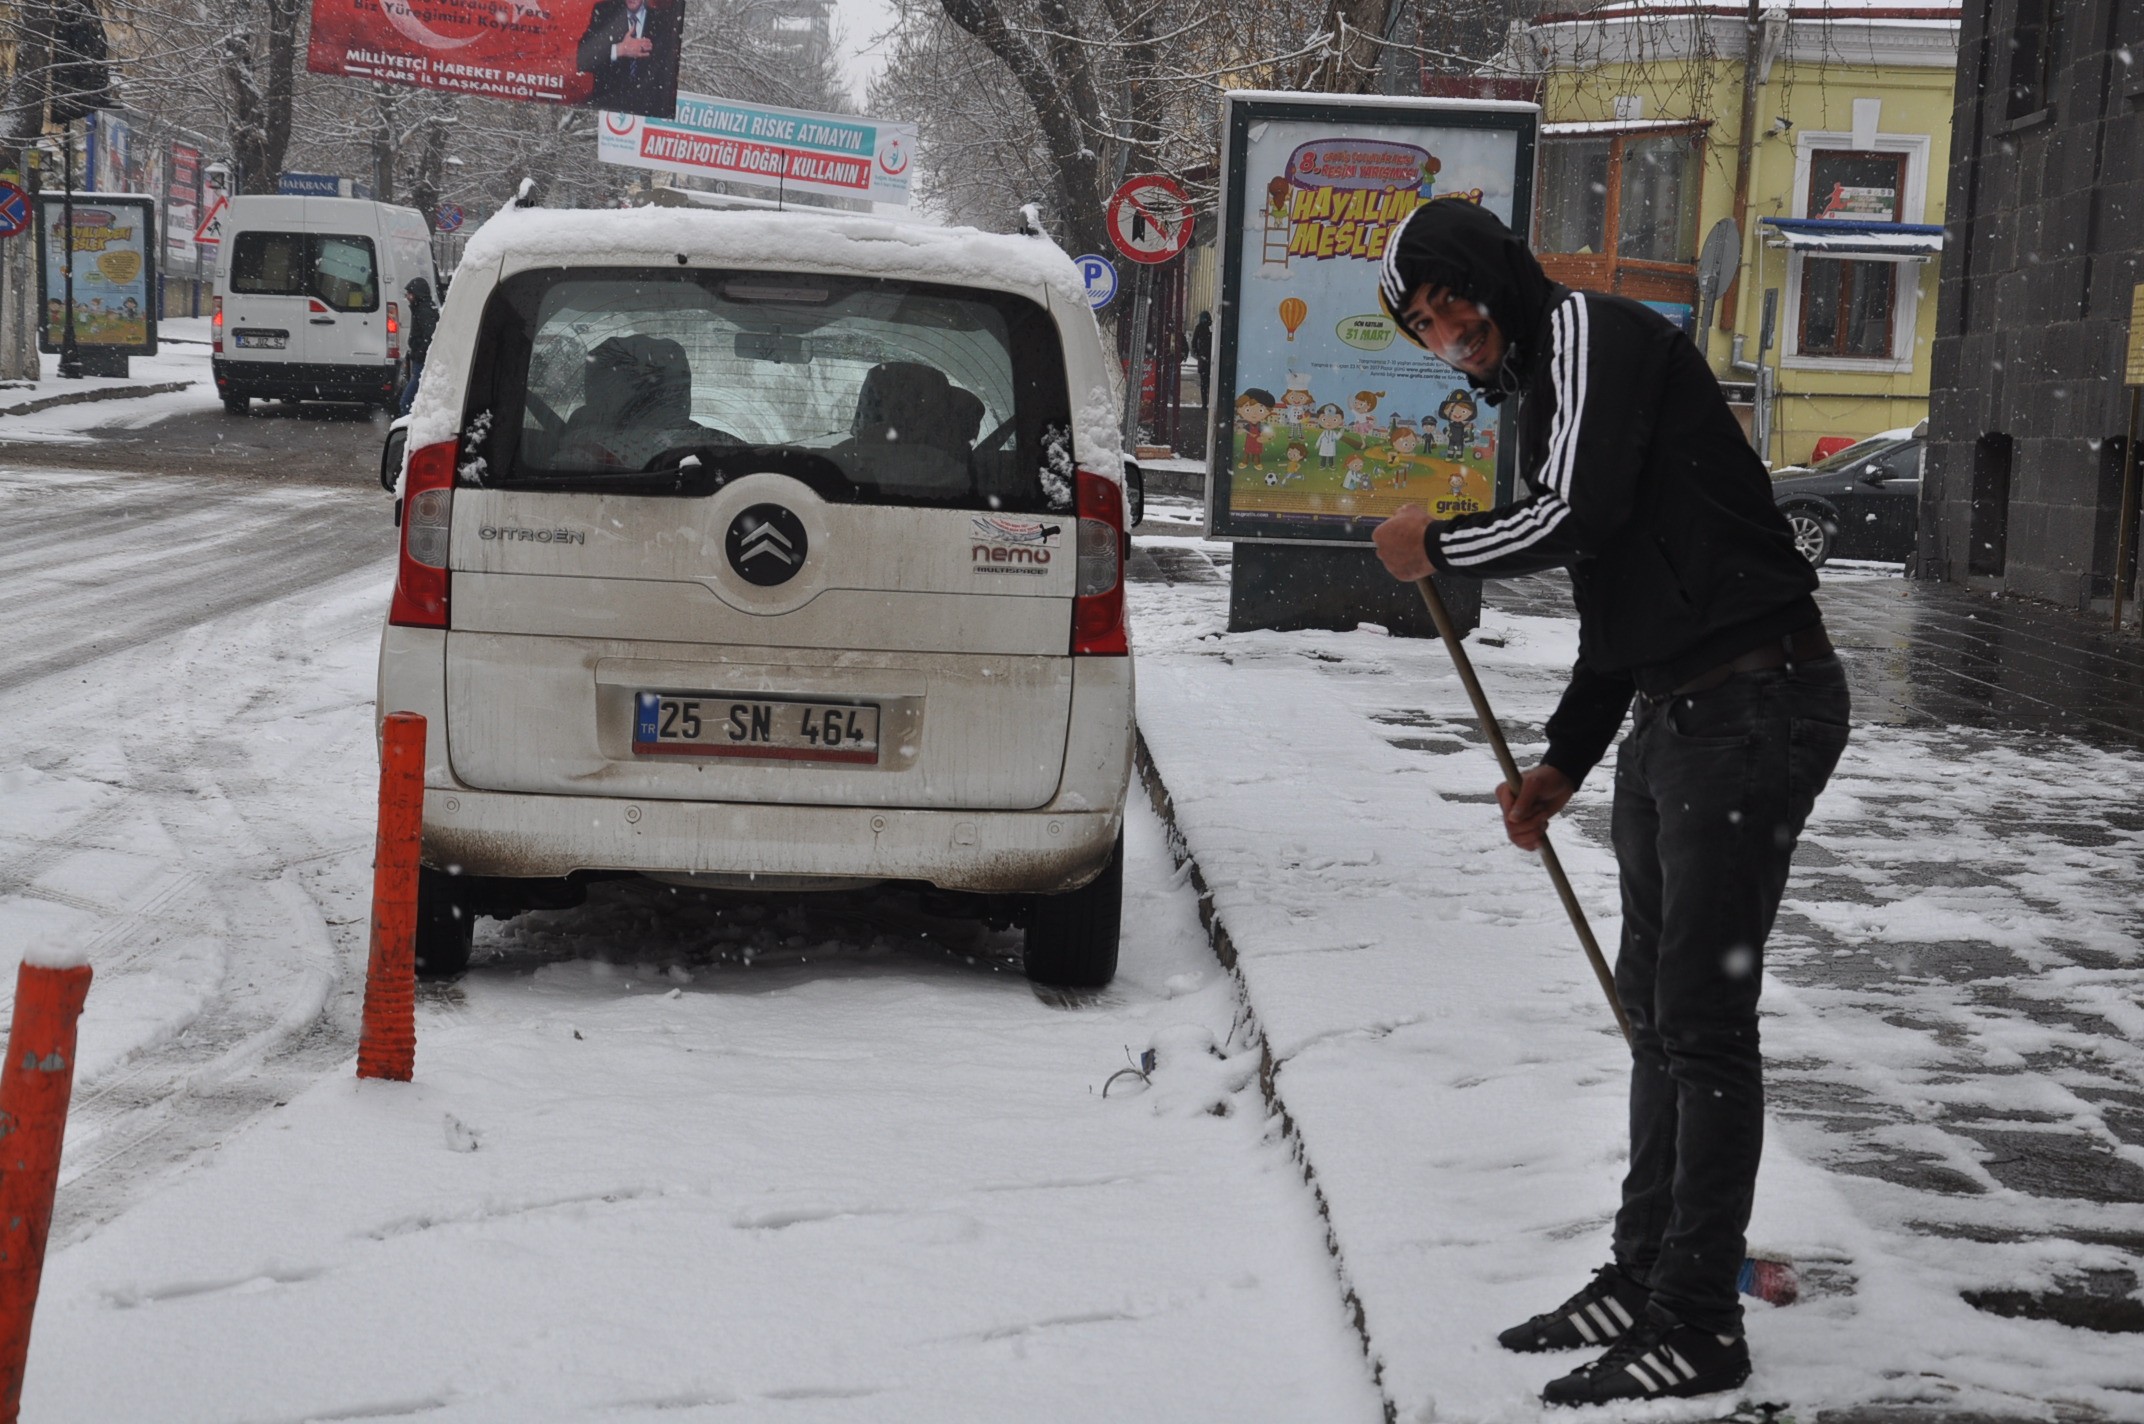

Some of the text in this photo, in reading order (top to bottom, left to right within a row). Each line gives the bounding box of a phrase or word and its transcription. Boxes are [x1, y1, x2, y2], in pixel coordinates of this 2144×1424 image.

[346, 48, 563, 88] MİLLİYETÇİ HAREKET PARTİSİ
[374, 68, 533, 96] KARS İL BAŞKANLIĞI
[660, 102, 863, 150] AĞLIĞINIZI RİSKE ATMAYIN
[644, 135, 739, 167] ANTİBİYOTİĞİ
[740, 149, 789, 174] DOĞRU
[791, 156, 859, 184] KULLANIN
[1289, 220, 1397, 262] MESLE
[1084, 263, 1102, 289] P
[1345, 328, 1391, 341] 31 MART
[1436, 499, 1479, 514] gratis
[478, 525, 585, 546] CITROËN
[972, 544, 1051, 565] nemo
[640, 723, 656, 734] TR
[659, 702, 864, 746] 25 SN 464
